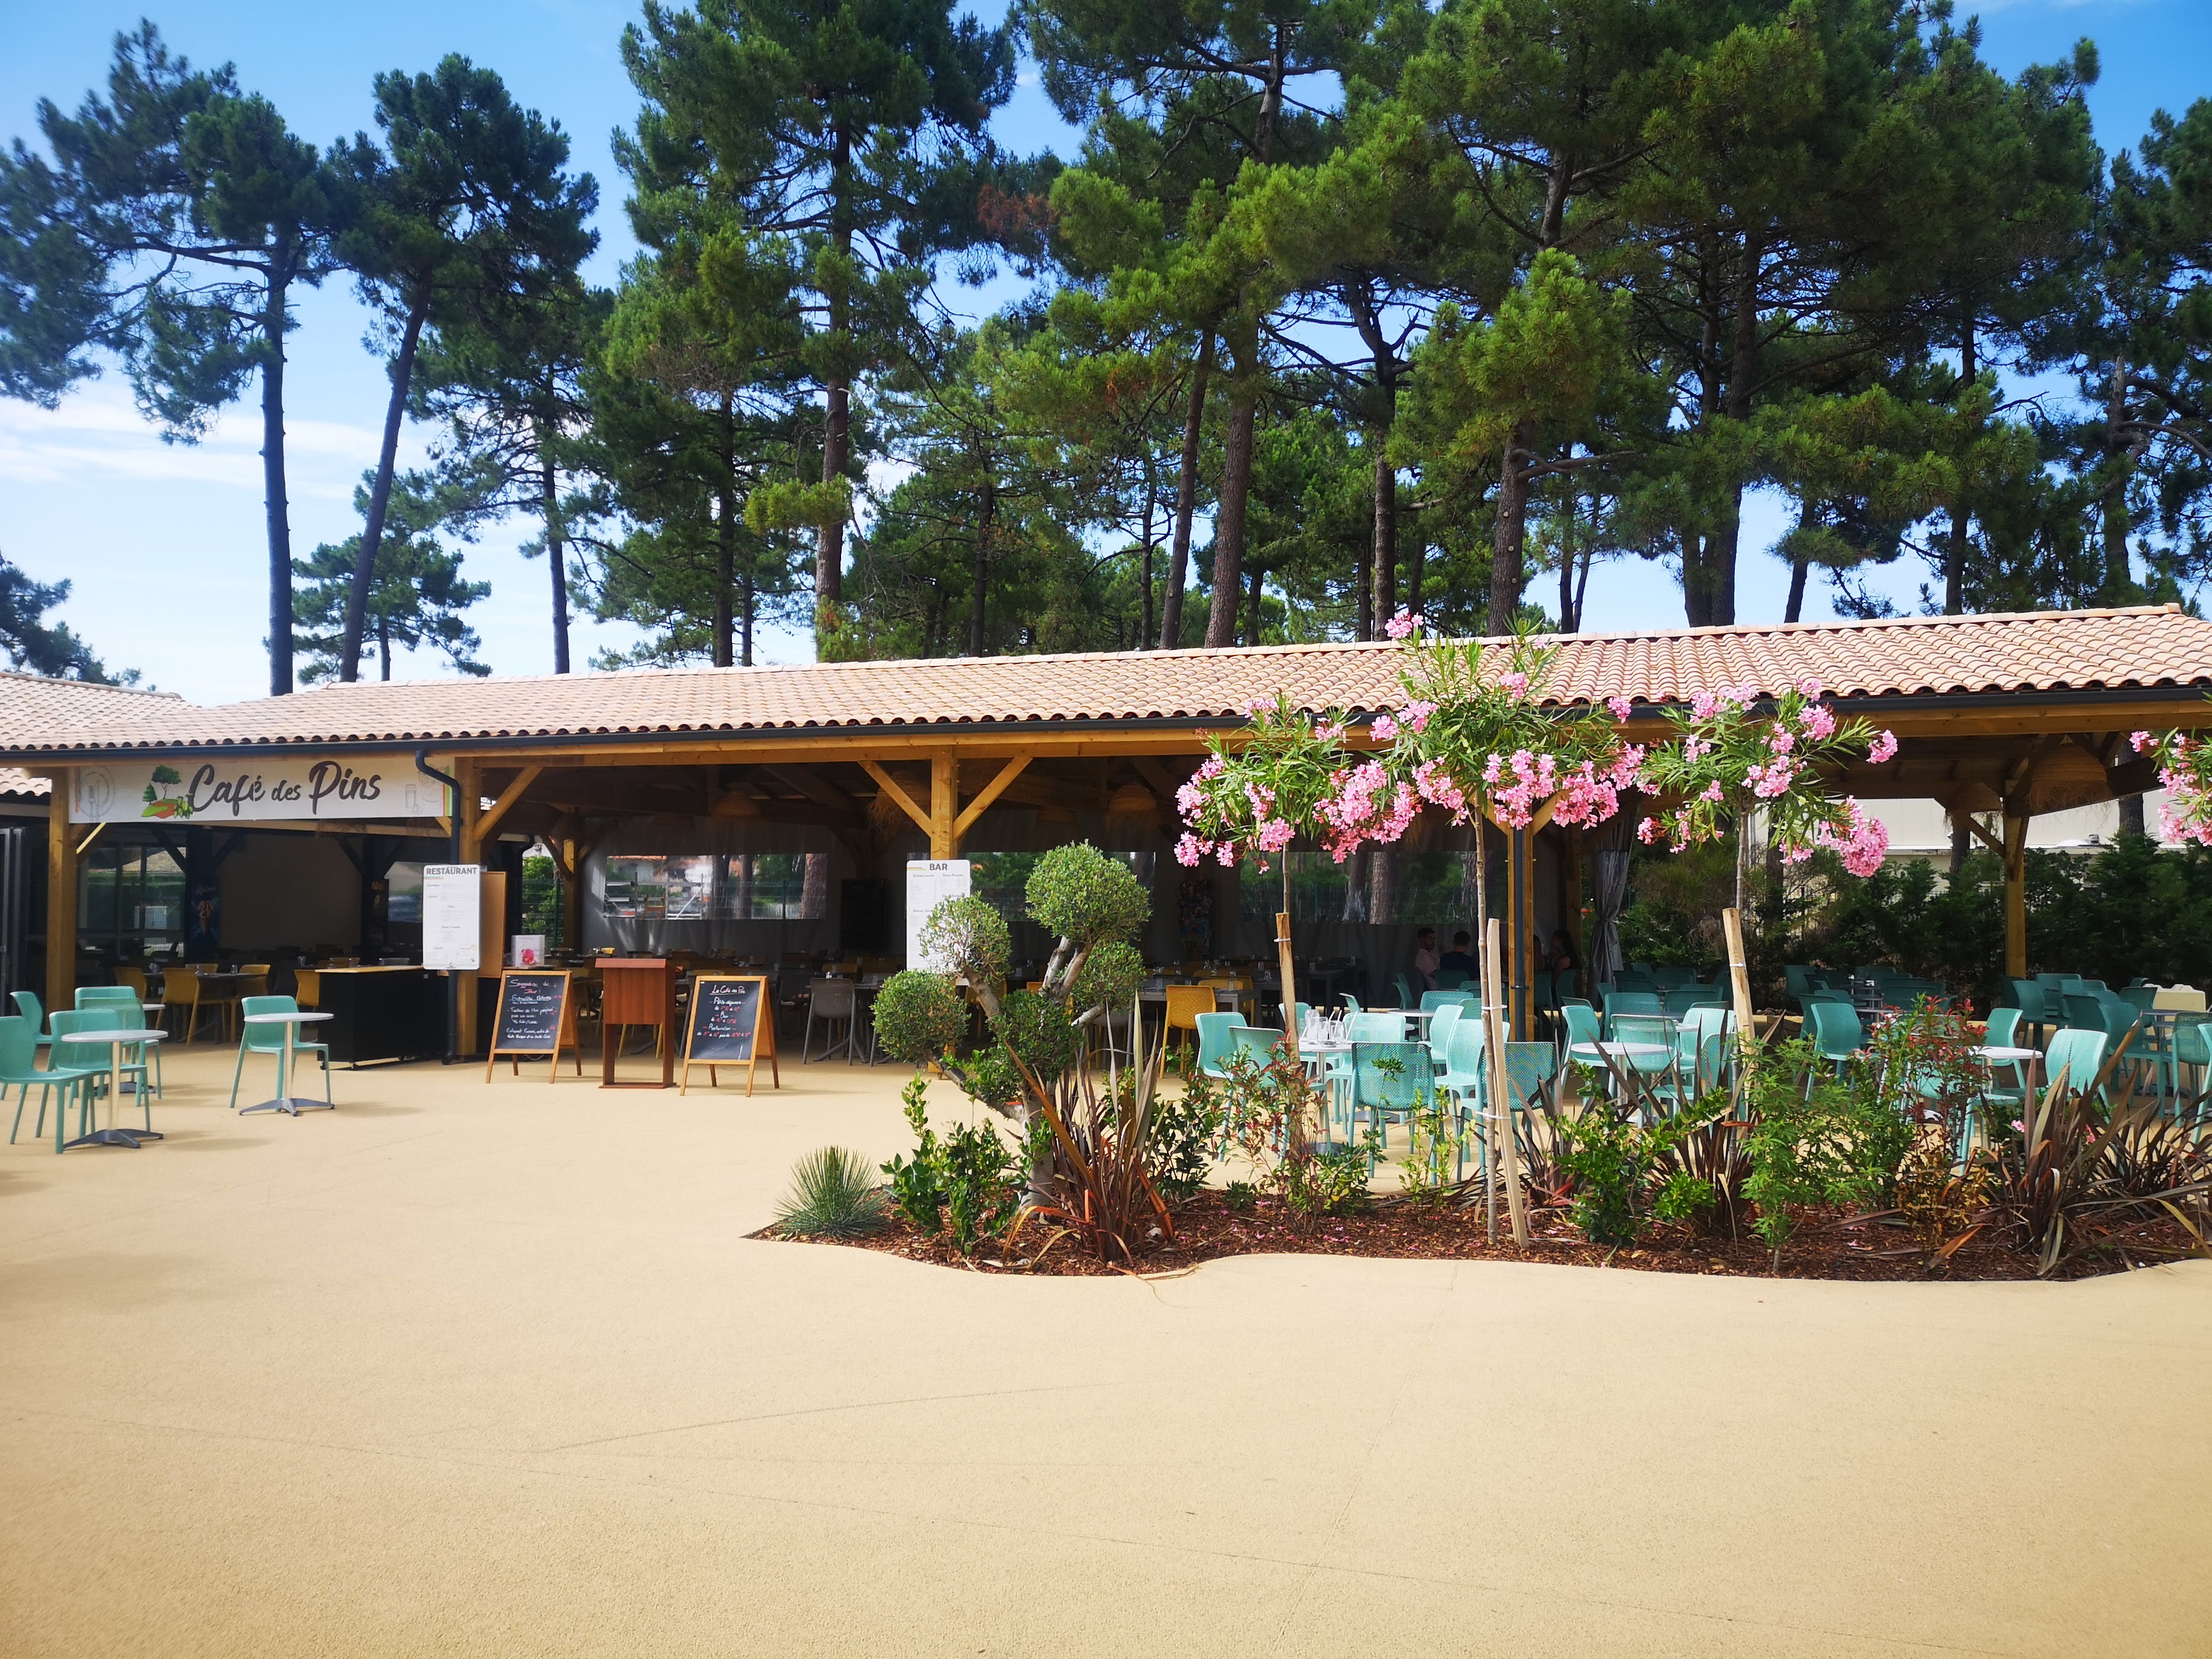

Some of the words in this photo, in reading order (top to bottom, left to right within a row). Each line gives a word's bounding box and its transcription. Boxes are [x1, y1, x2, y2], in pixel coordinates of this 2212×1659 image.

[189, 764, 266, 817] Café
[271, 780, 301, 802] des
[309, 760, 381, 815] Pins
